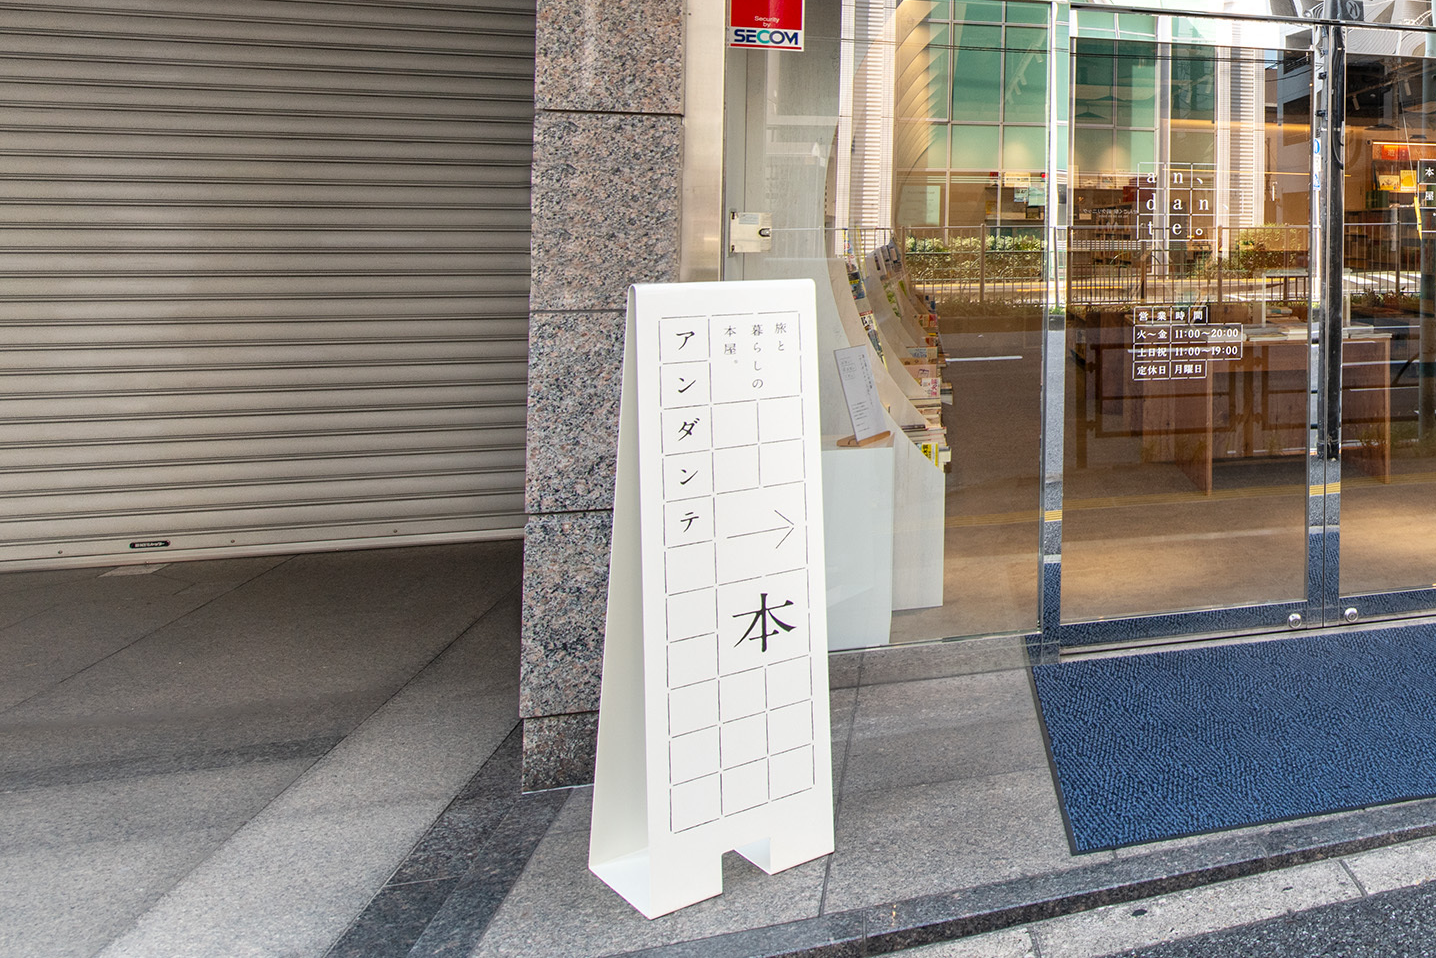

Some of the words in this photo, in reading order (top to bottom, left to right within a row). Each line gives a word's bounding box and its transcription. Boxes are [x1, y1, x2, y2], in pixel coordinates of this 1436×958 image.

[754, 15, 780, 24] Security
[734, 29, 799, 45] SECOM
[1138, 311, 1204, 322] 営業時間
[724, 325, 739, 364] 本屋。
[775, 322, 787, 351] 旅と
[751, 324, 764, 389] 暮らしの
[1137, 346, 1168, 357] 土日祝
[1137, 365, 1167, 376] 定休日
[1174, 364, 1203, 375] 月曜日
[676, 331, 700, 533] アンダンテ
[732, 592, 797, 653] 本
